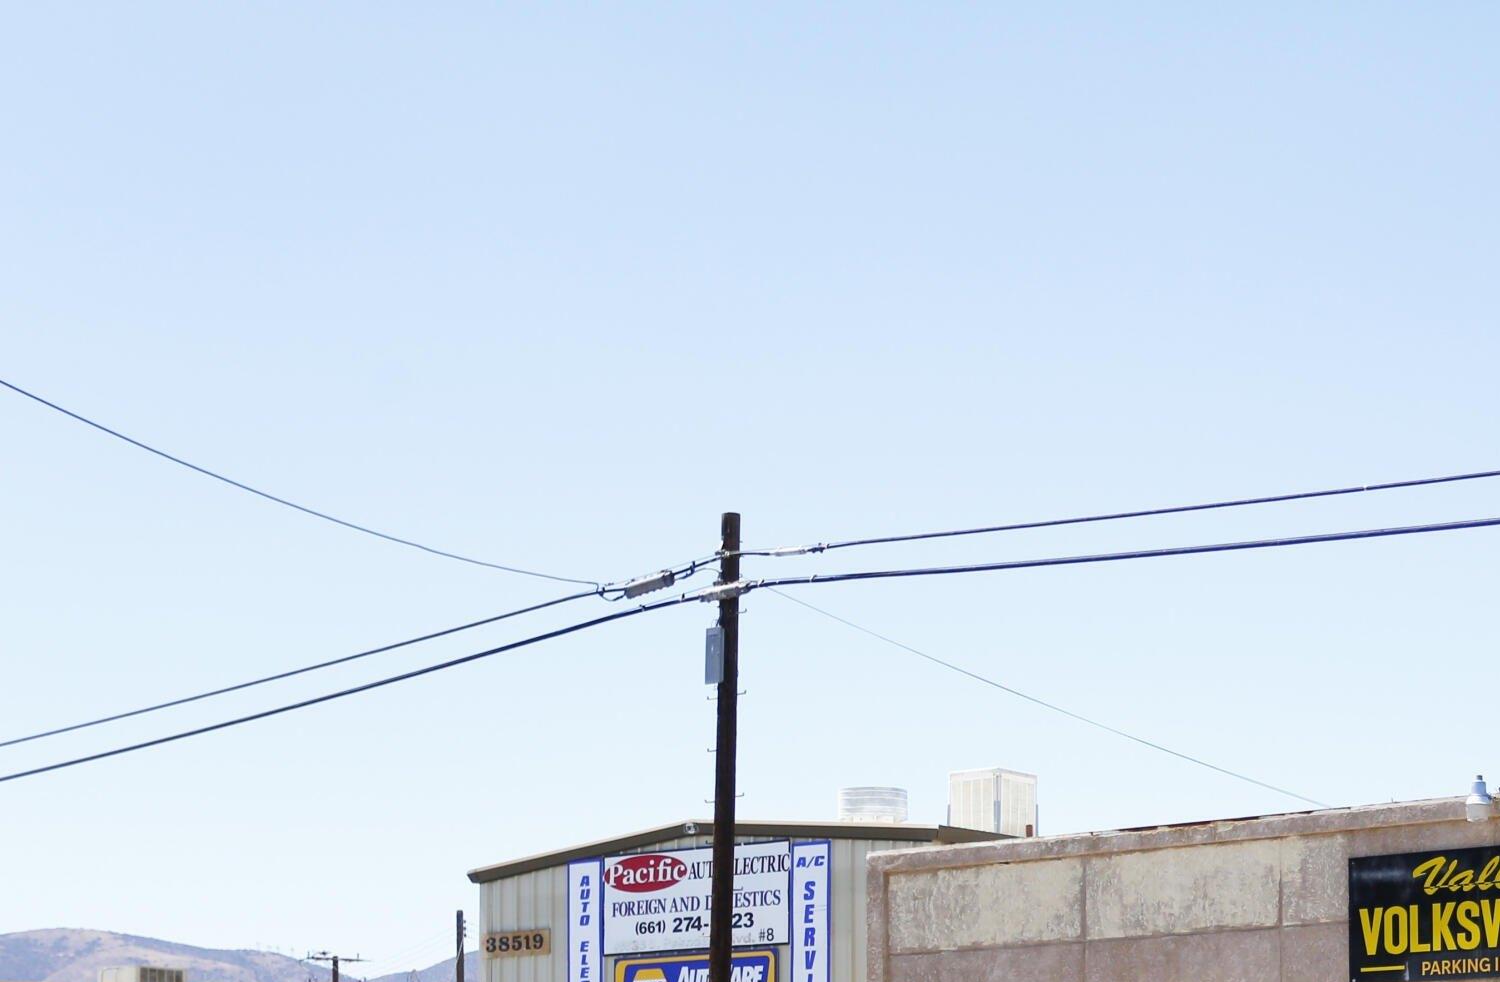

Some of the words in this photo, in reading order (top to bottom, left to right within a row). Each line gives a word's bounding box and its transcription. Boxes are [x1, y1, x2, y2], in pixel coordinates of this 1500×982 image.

[604, 857, 686, 887] Pacific
[689, 861, 713, 880] AUT
[734, 853, 790, 876] LECTRIC
[796, 854, 825, 869] A/C
[579, 875, 591, 927] AUTO
[612, 897, 667, 918] FOREIGN
[670, 895, 700, 913] AND
[635, 920, 666, 936] (661)
[672, 912, 754, 933] 274-23
[486, 936, 544, 953] 38519
[759, 928, 775, 942] #8
[1421, 957, 1491, 976] PARKING
